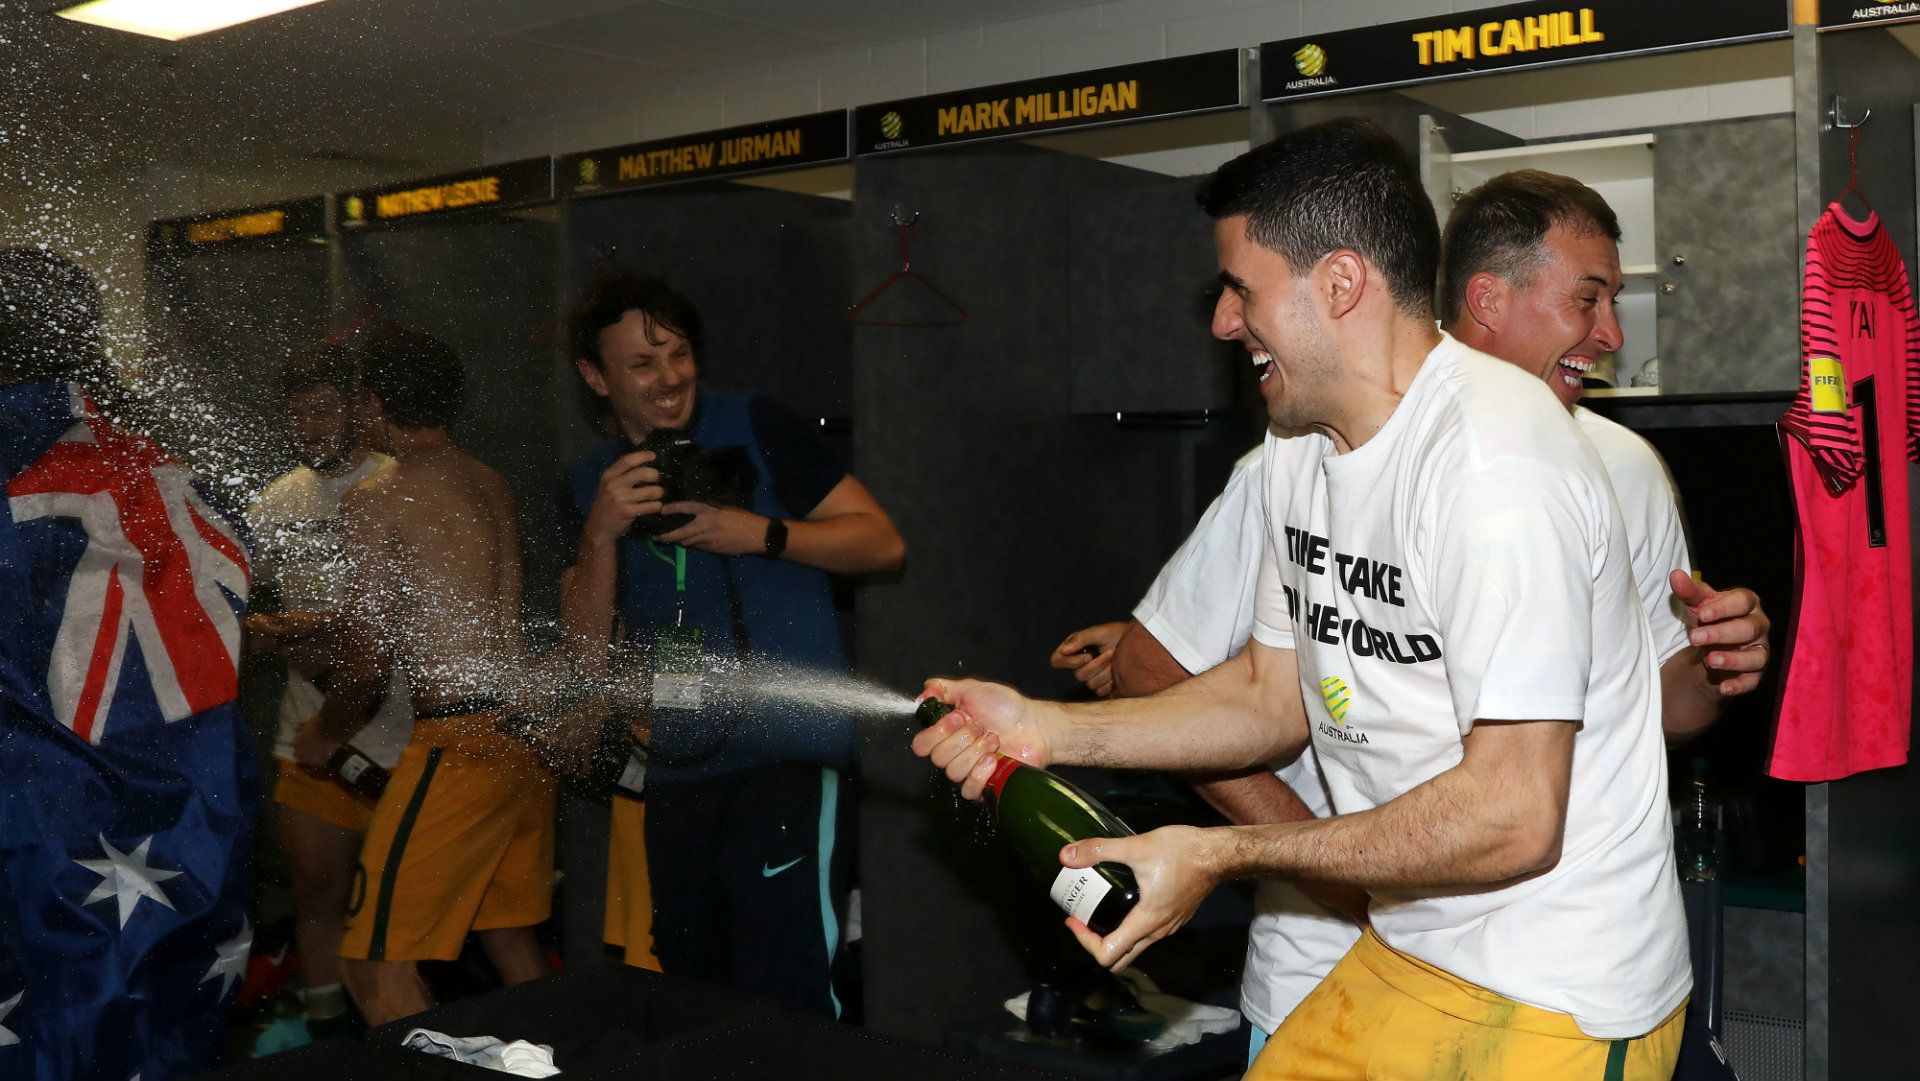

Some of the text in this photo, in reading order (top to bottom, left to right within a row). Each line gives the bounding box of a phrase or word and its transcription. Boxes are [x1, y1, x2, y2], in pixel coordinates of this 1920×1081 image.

[1852, 2, 1919, 19] AUSTRALIA
[1412, 8, 1604, 66] TIM CAHILL
[938, 80, 1137, 136] MARK MILLIGAN
[1286, 76, 1335, 90] AUSTRALIA
[619, 129, 801, 180] MATTHEW JURMAN
[1815, 376, 1841, 385] FIFA
[1851, 374, 1887, 548] 1
[1335, 553, 1405, 607] TAKE
[1318, 721, 1369, 744] AUSTRALIA
